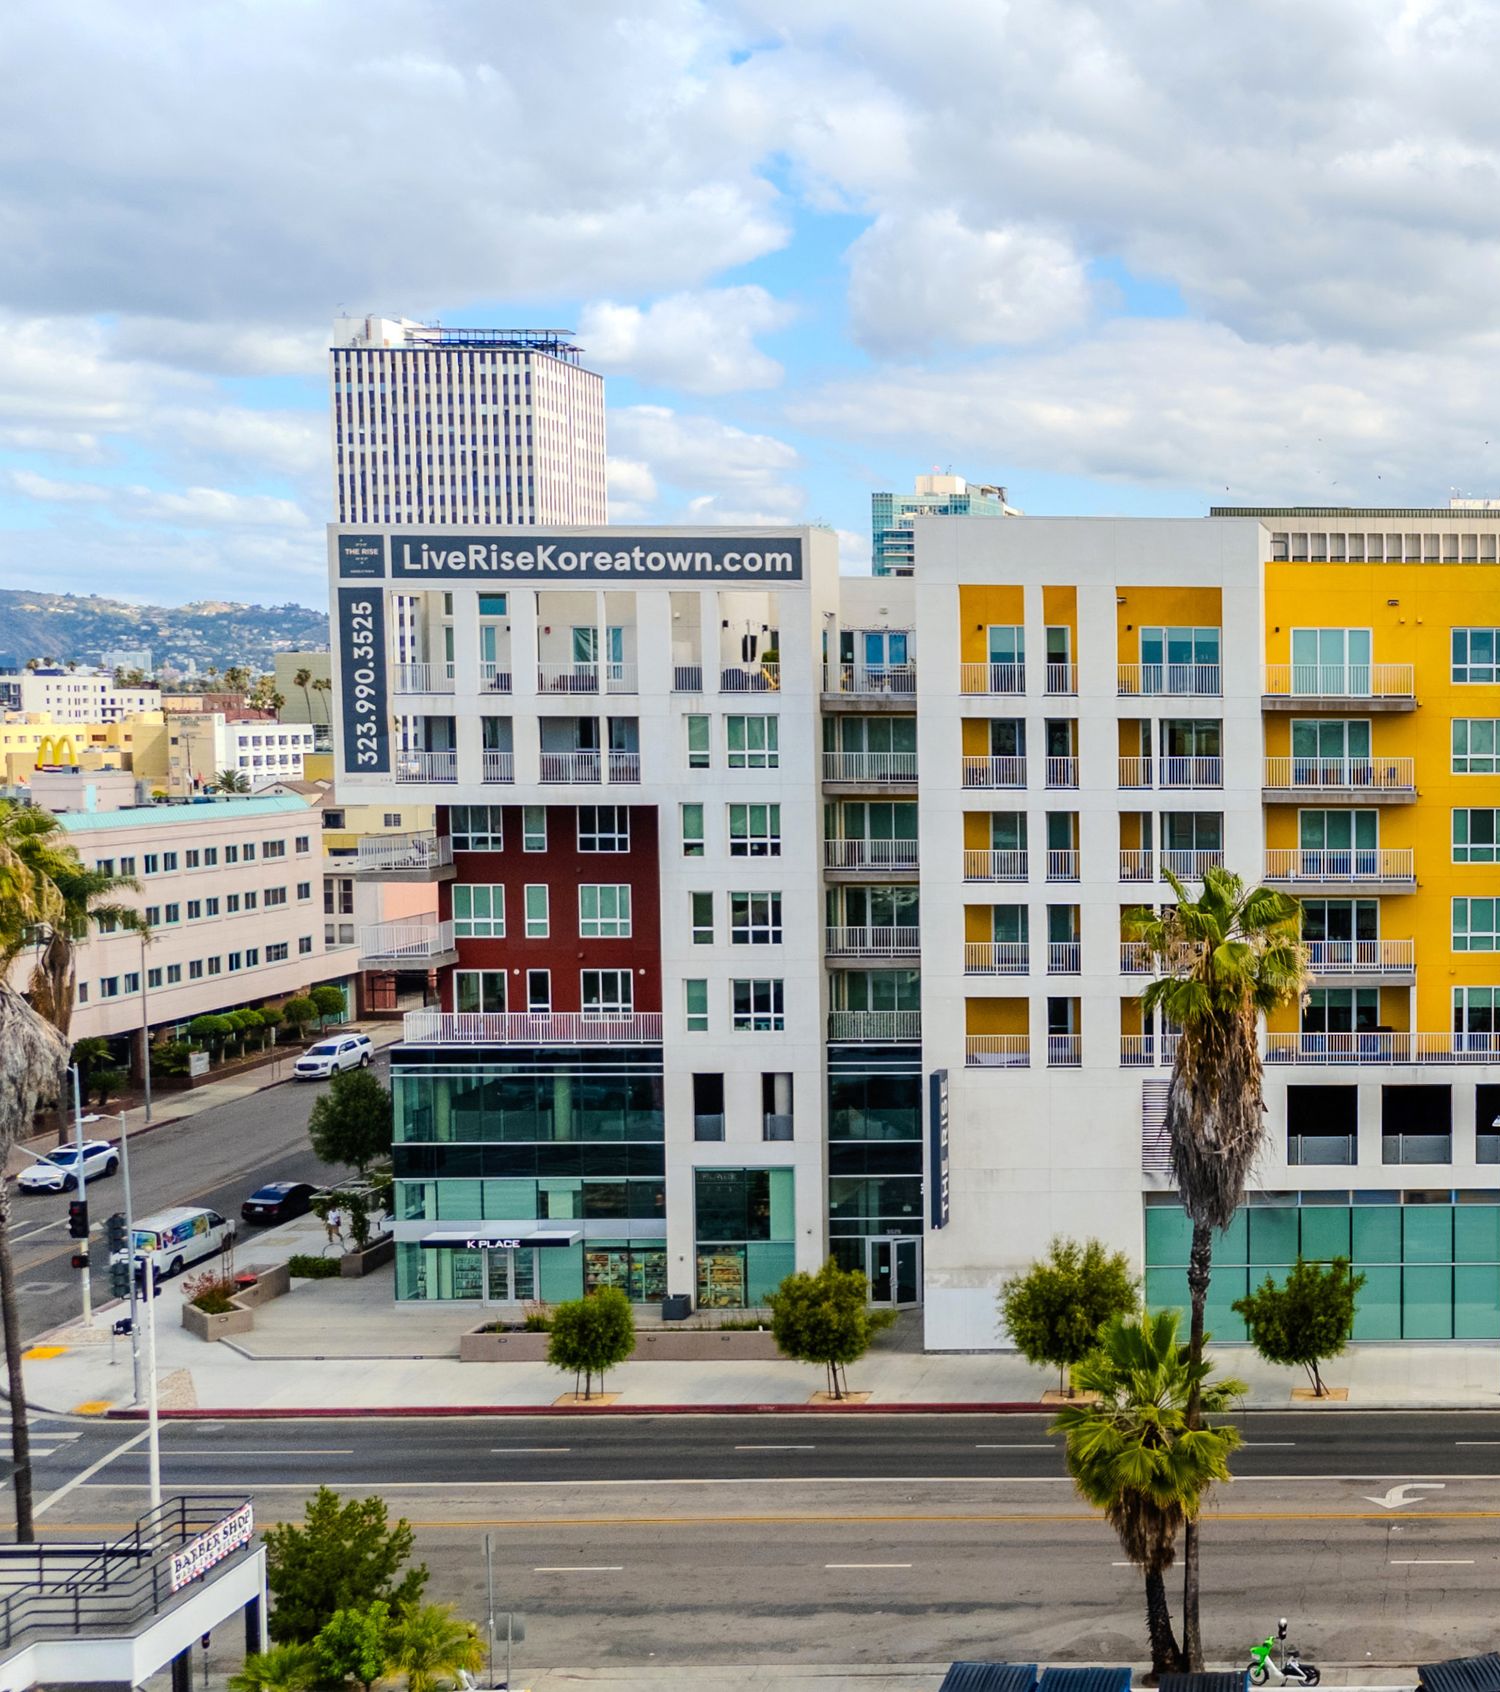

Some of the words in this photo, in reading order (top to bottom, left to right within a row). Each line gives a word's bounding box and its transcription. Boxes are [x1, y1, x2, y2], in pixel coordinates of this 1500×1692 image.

[403, 543, 792, 573] LiveRiseKoreatown.com
[351, 601, 378, 765] 323.990.3525
[940, 1078, 948, 1147] RISE
[941, 1157, 949, 1218] THE
[467, 1240, 476, 1248] K
[478, 1240, 520, 1248] PLACE
[174, 1534, 220, 1573] BARBER
[223, 1510, 250, 1540] SHOP
